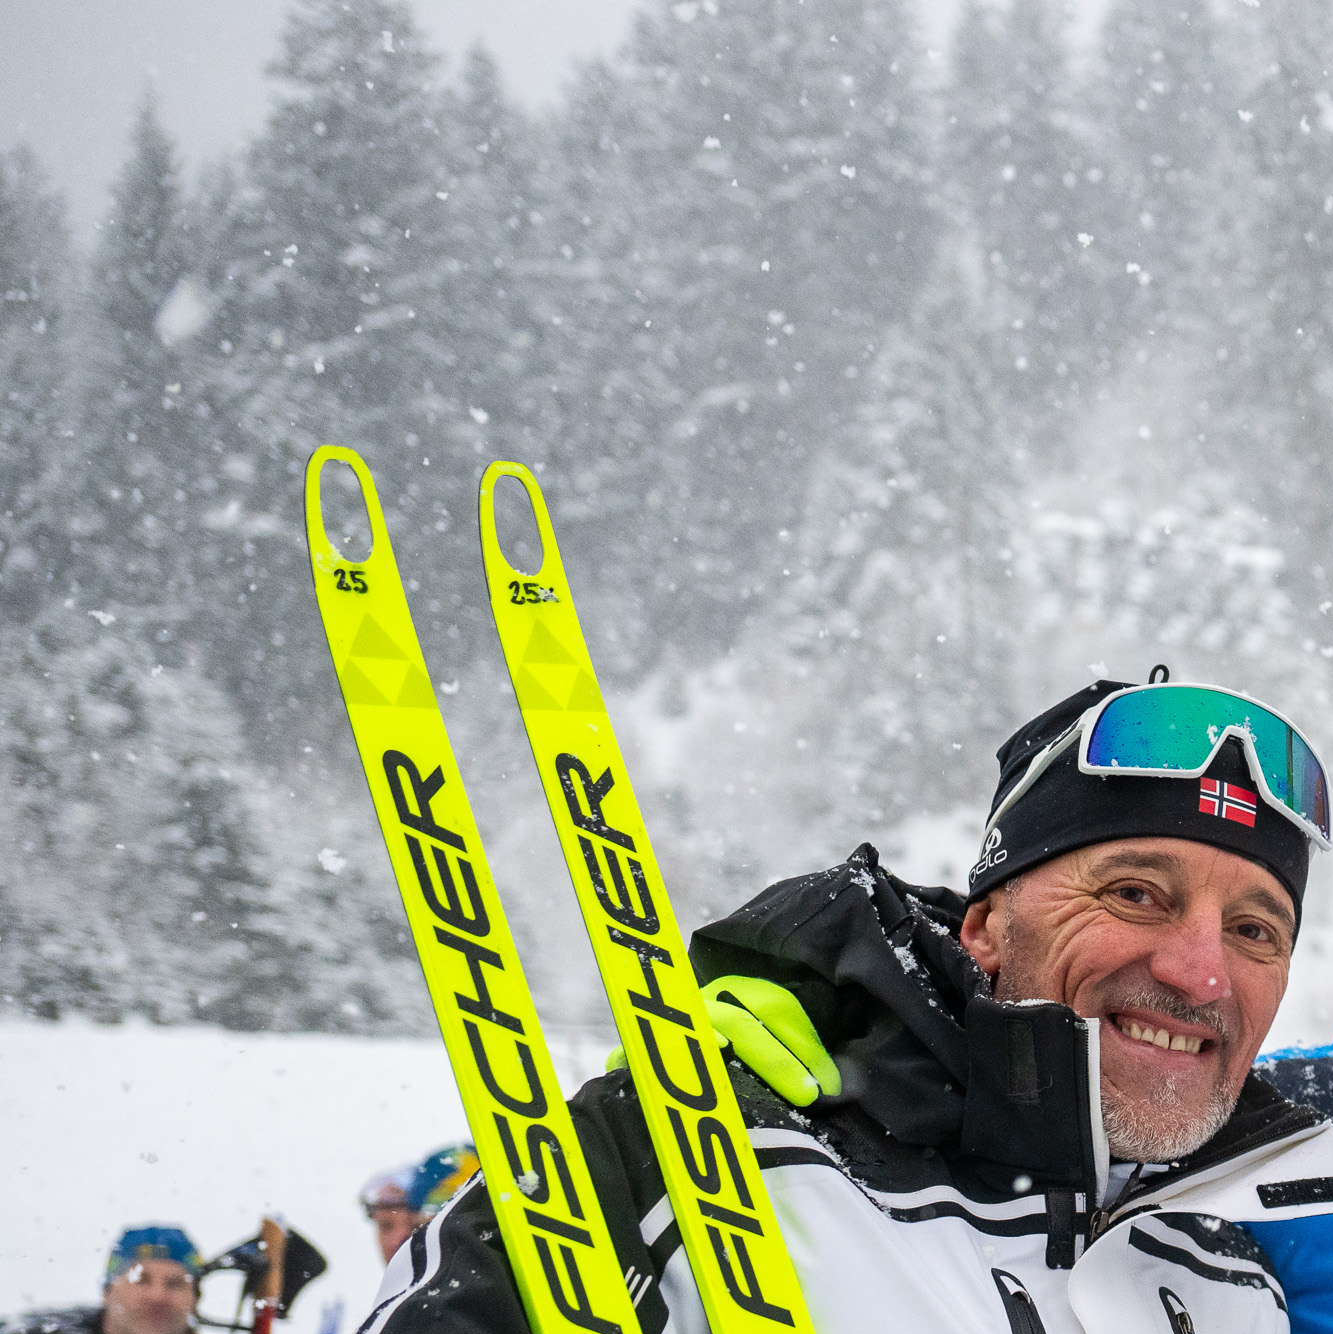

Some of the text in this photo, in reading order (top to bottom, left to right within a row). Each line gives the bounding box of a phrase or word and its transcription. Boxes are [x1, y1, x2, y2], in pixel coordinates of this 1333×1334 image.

[334, 568, 369, 594] 25
[968, 849, 1008, 884] odlo
[555, 752, 796, 1328] FISCHER
